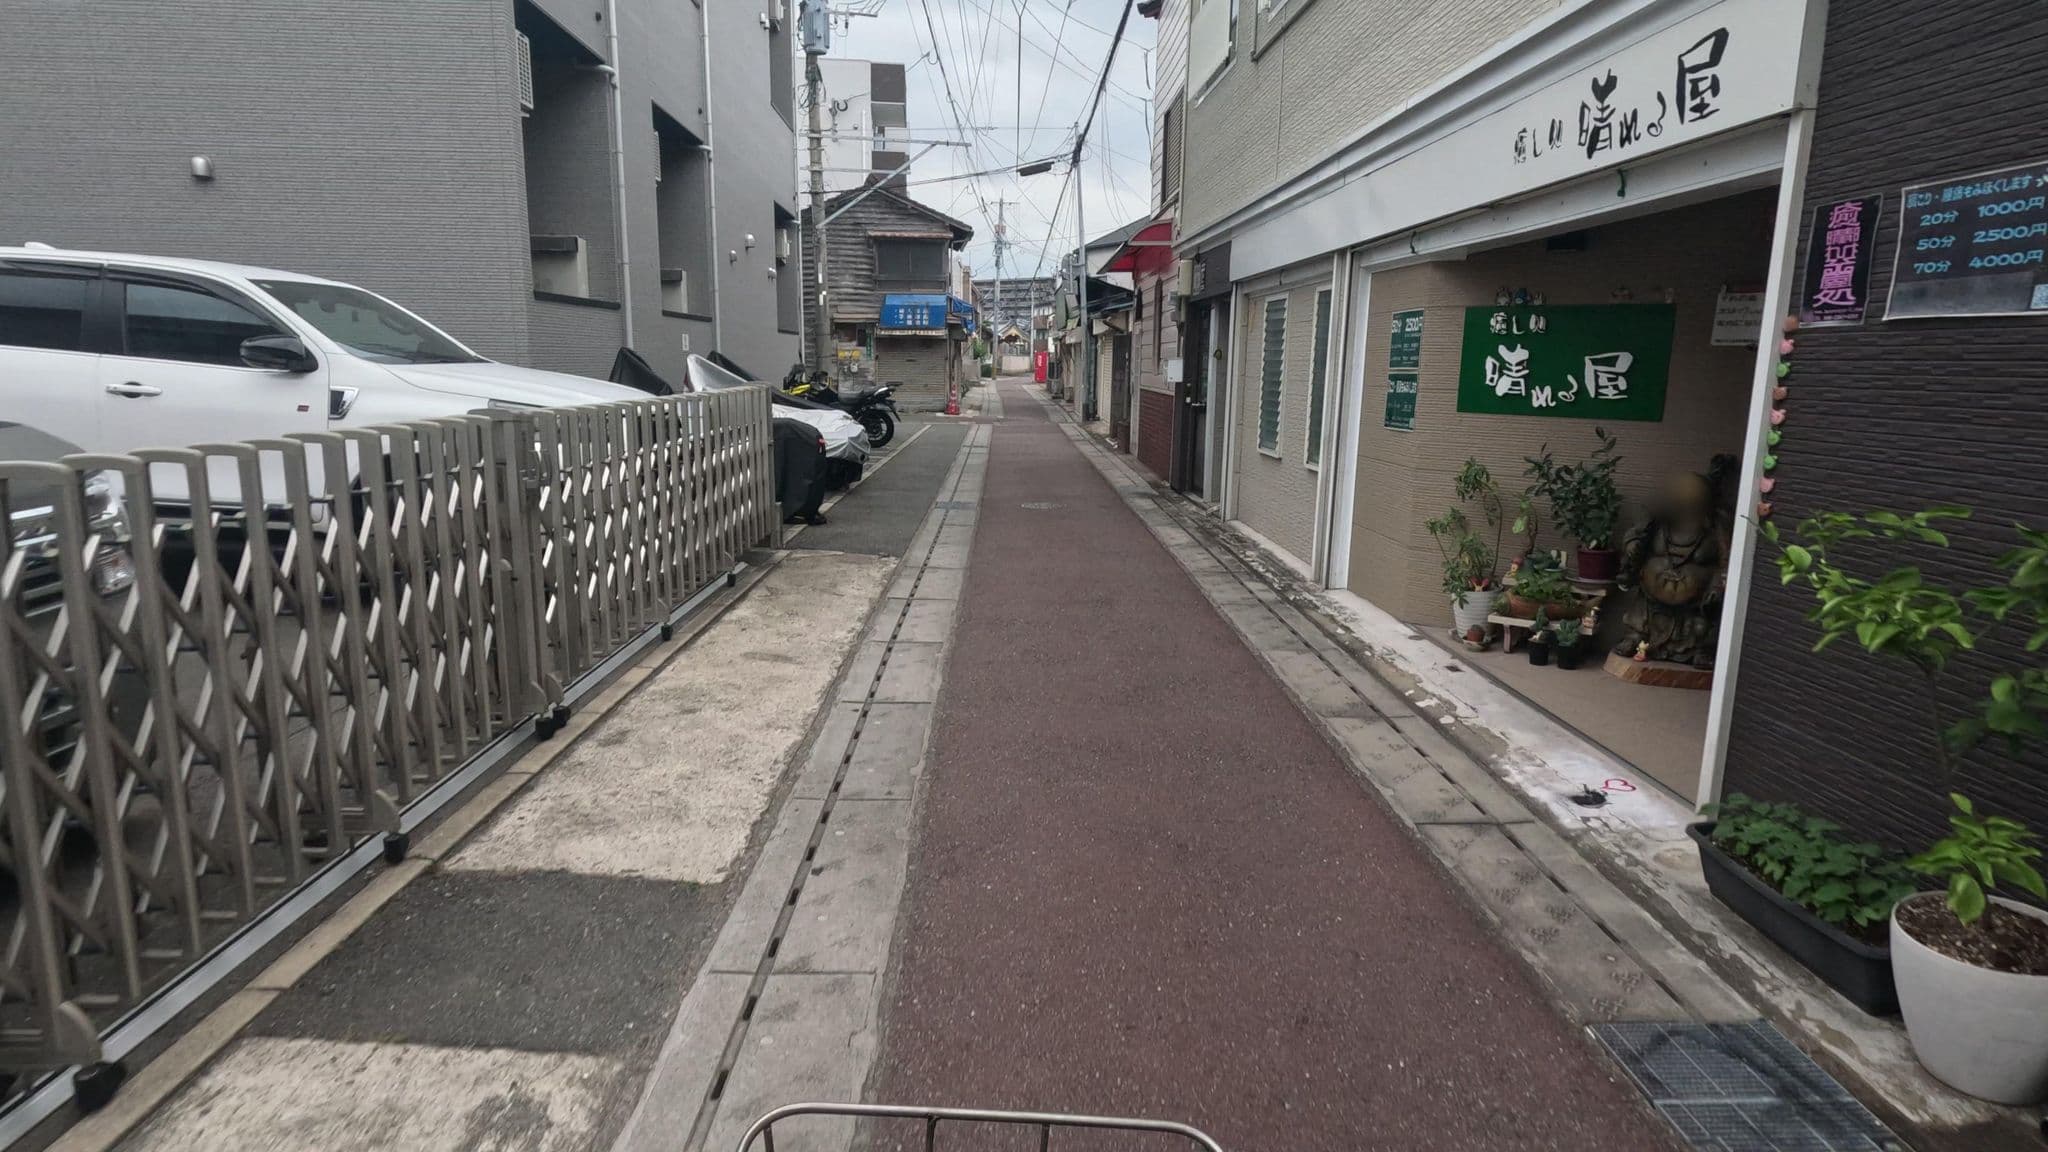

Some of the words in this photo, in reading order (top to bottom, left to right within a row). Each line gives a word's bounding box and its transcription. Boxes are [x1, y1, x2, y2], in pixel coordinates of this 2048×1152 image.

[1577, 27, 1730, 160] 晴れる屋
[1919, 209, 1959, 227] 20分
[1977, 195, 2046, 219] 1000円
[1915, 235, 1956, 251] 50分
[1971, 222, 2048, 244] 2500円
[1913, 260, 1953, 275] 70分
[1968, 249, 2044, 270] 4000円
[1484, 343, 1634, 408] 晴れる屋
